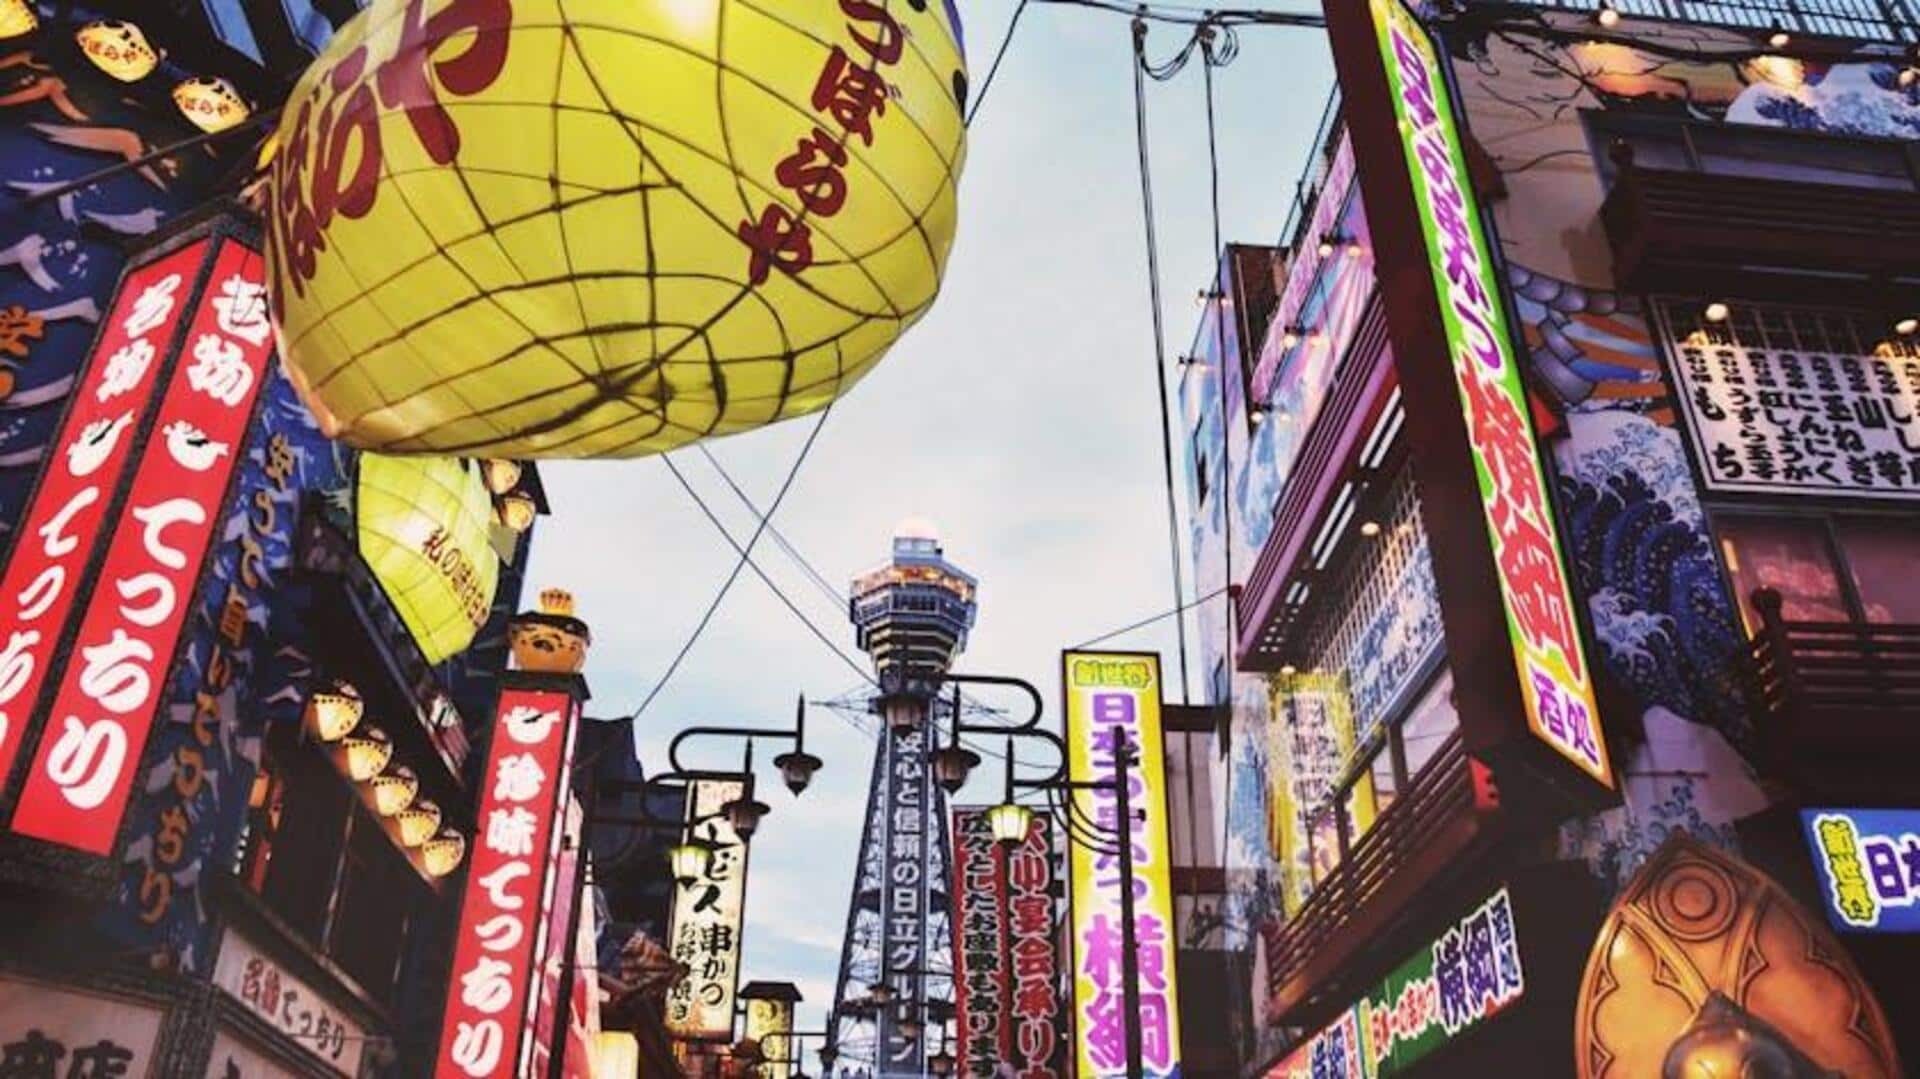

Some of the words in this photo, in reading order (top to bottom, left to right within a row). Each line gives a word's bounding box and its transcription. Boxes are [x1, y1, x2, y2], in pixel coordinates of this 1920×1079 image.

[1694, 385, 1744, 479] もち
[1787, 391, 1843, 485] にんにく
[44, 497, 207, 811] てっちり
[451, 752, 547, 1078] 珍味てっちり
[701, 921, 733, 1006] 串かつ
